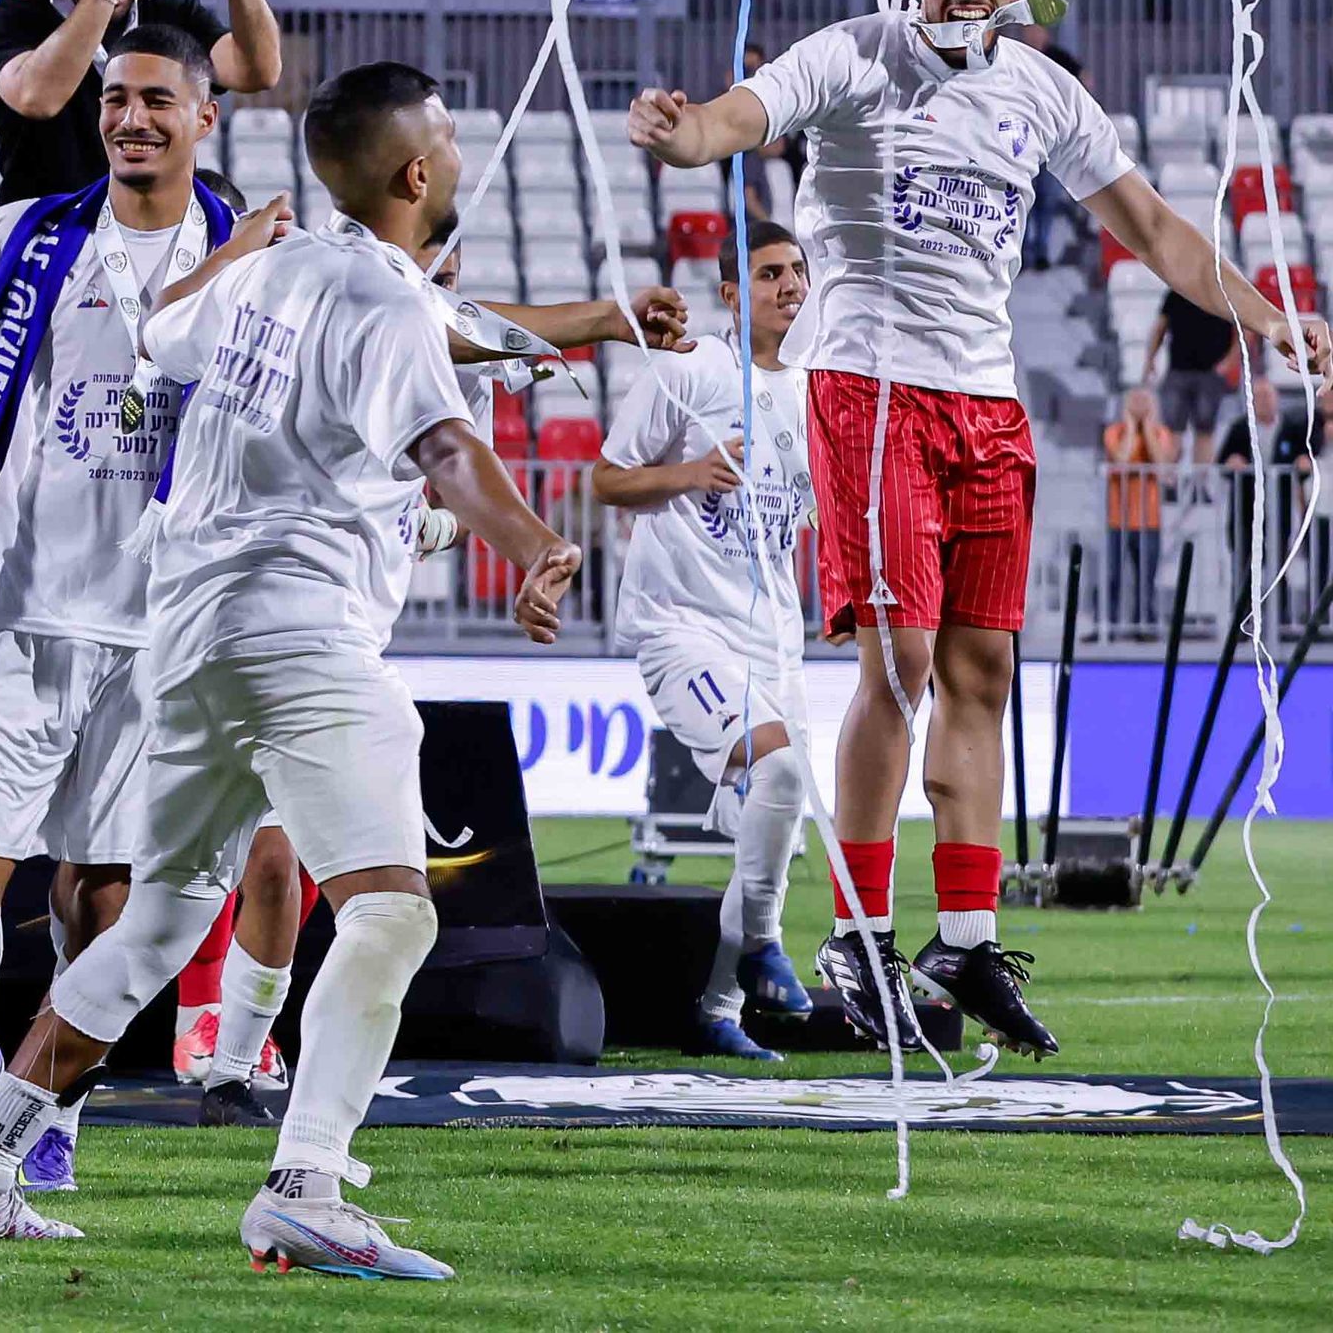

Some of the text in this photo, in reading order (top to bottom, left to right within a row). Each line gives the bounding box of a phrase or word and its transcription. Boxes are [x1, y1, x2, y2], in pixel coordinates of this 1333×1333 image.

[919, 239, 968, 255] 2022-2023
[113, 435, 159, 455] לנוער
[88, 468, 146, 481] 2022-2023
[687, 669, 726, 715] 11
